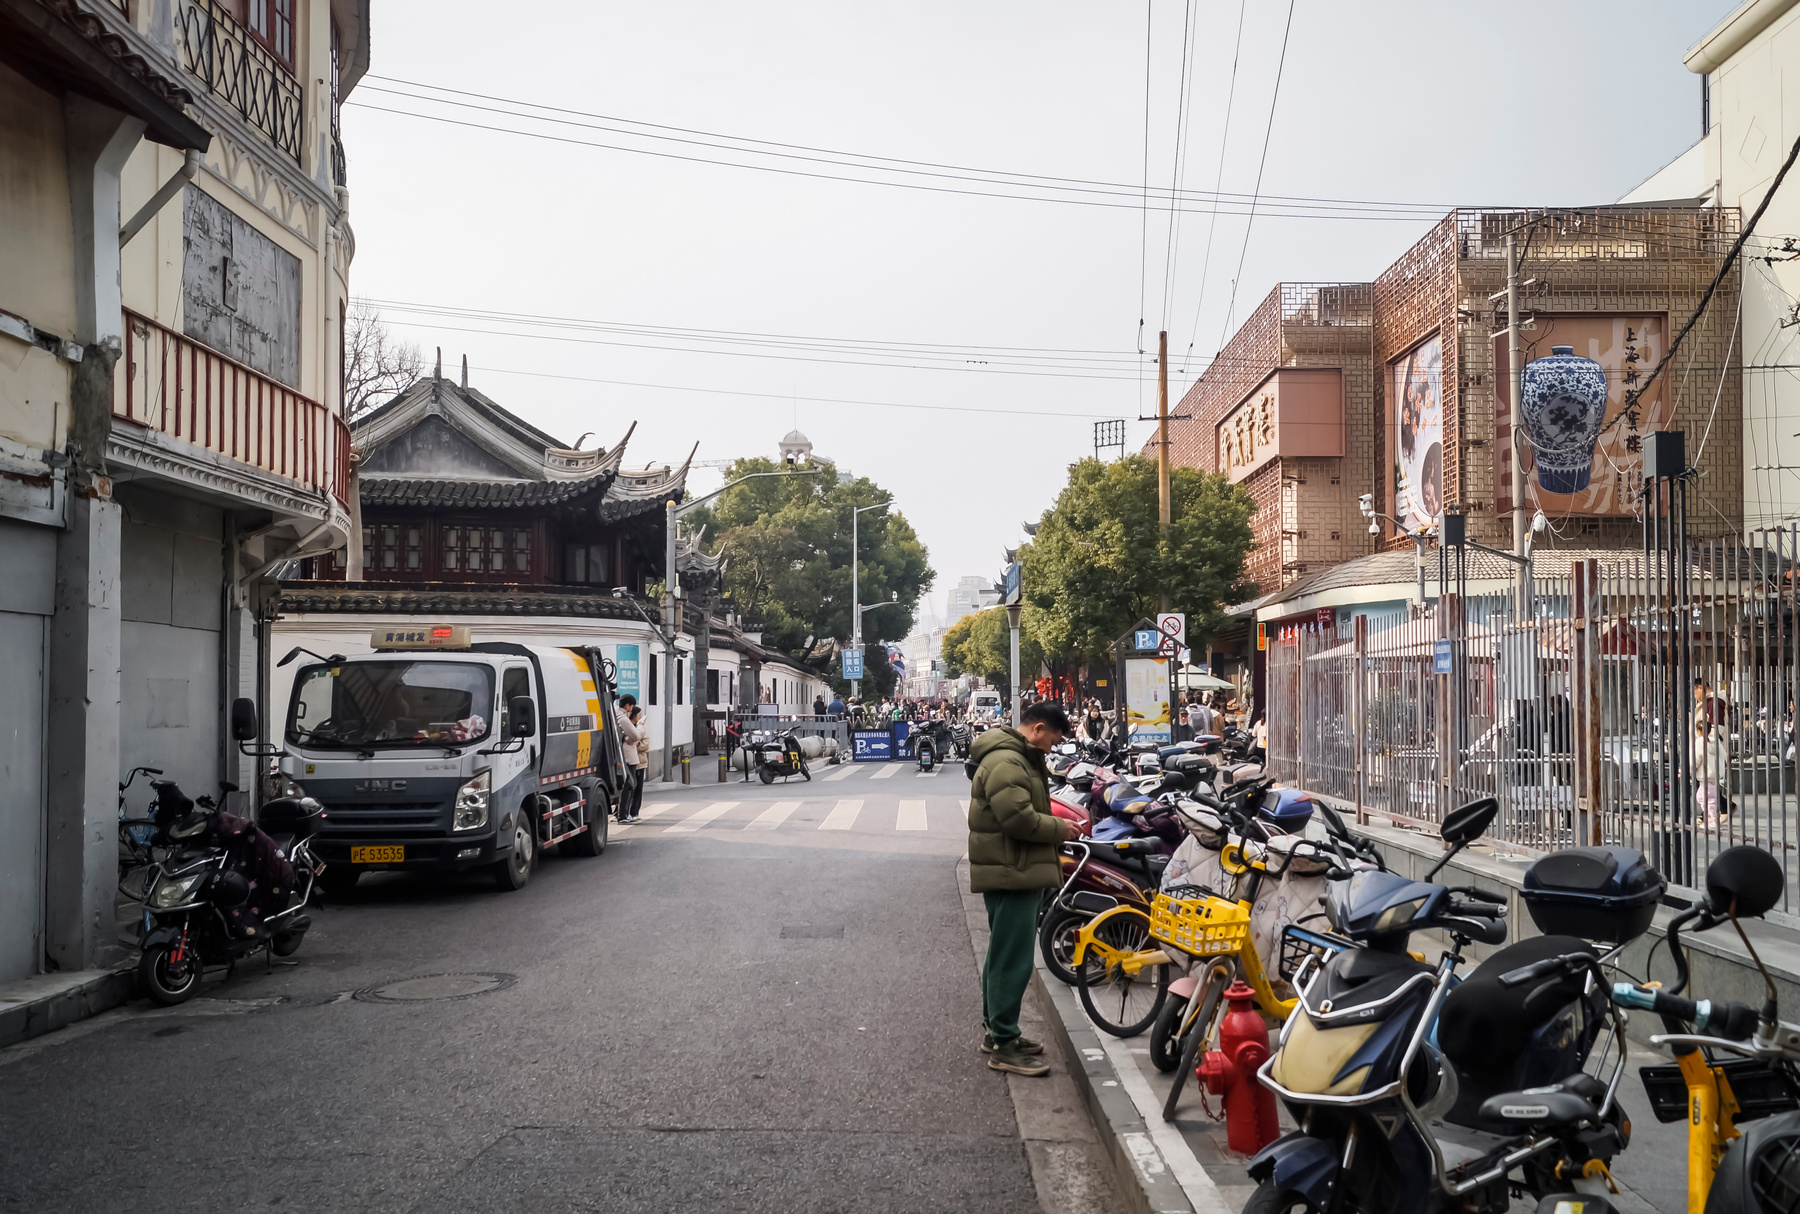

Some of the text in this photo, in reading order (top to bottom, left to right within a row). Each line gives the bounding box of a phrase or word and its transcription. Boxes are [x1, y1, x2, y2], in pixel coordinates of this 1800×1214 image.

[385, 632, 425, 642] 黄浦城发
[1137, 632, 1150, 648] P
[846, 665, 860, 673] 入口
[854, 739, 867, 754] P
[355, 780, 407, 791] JMC
